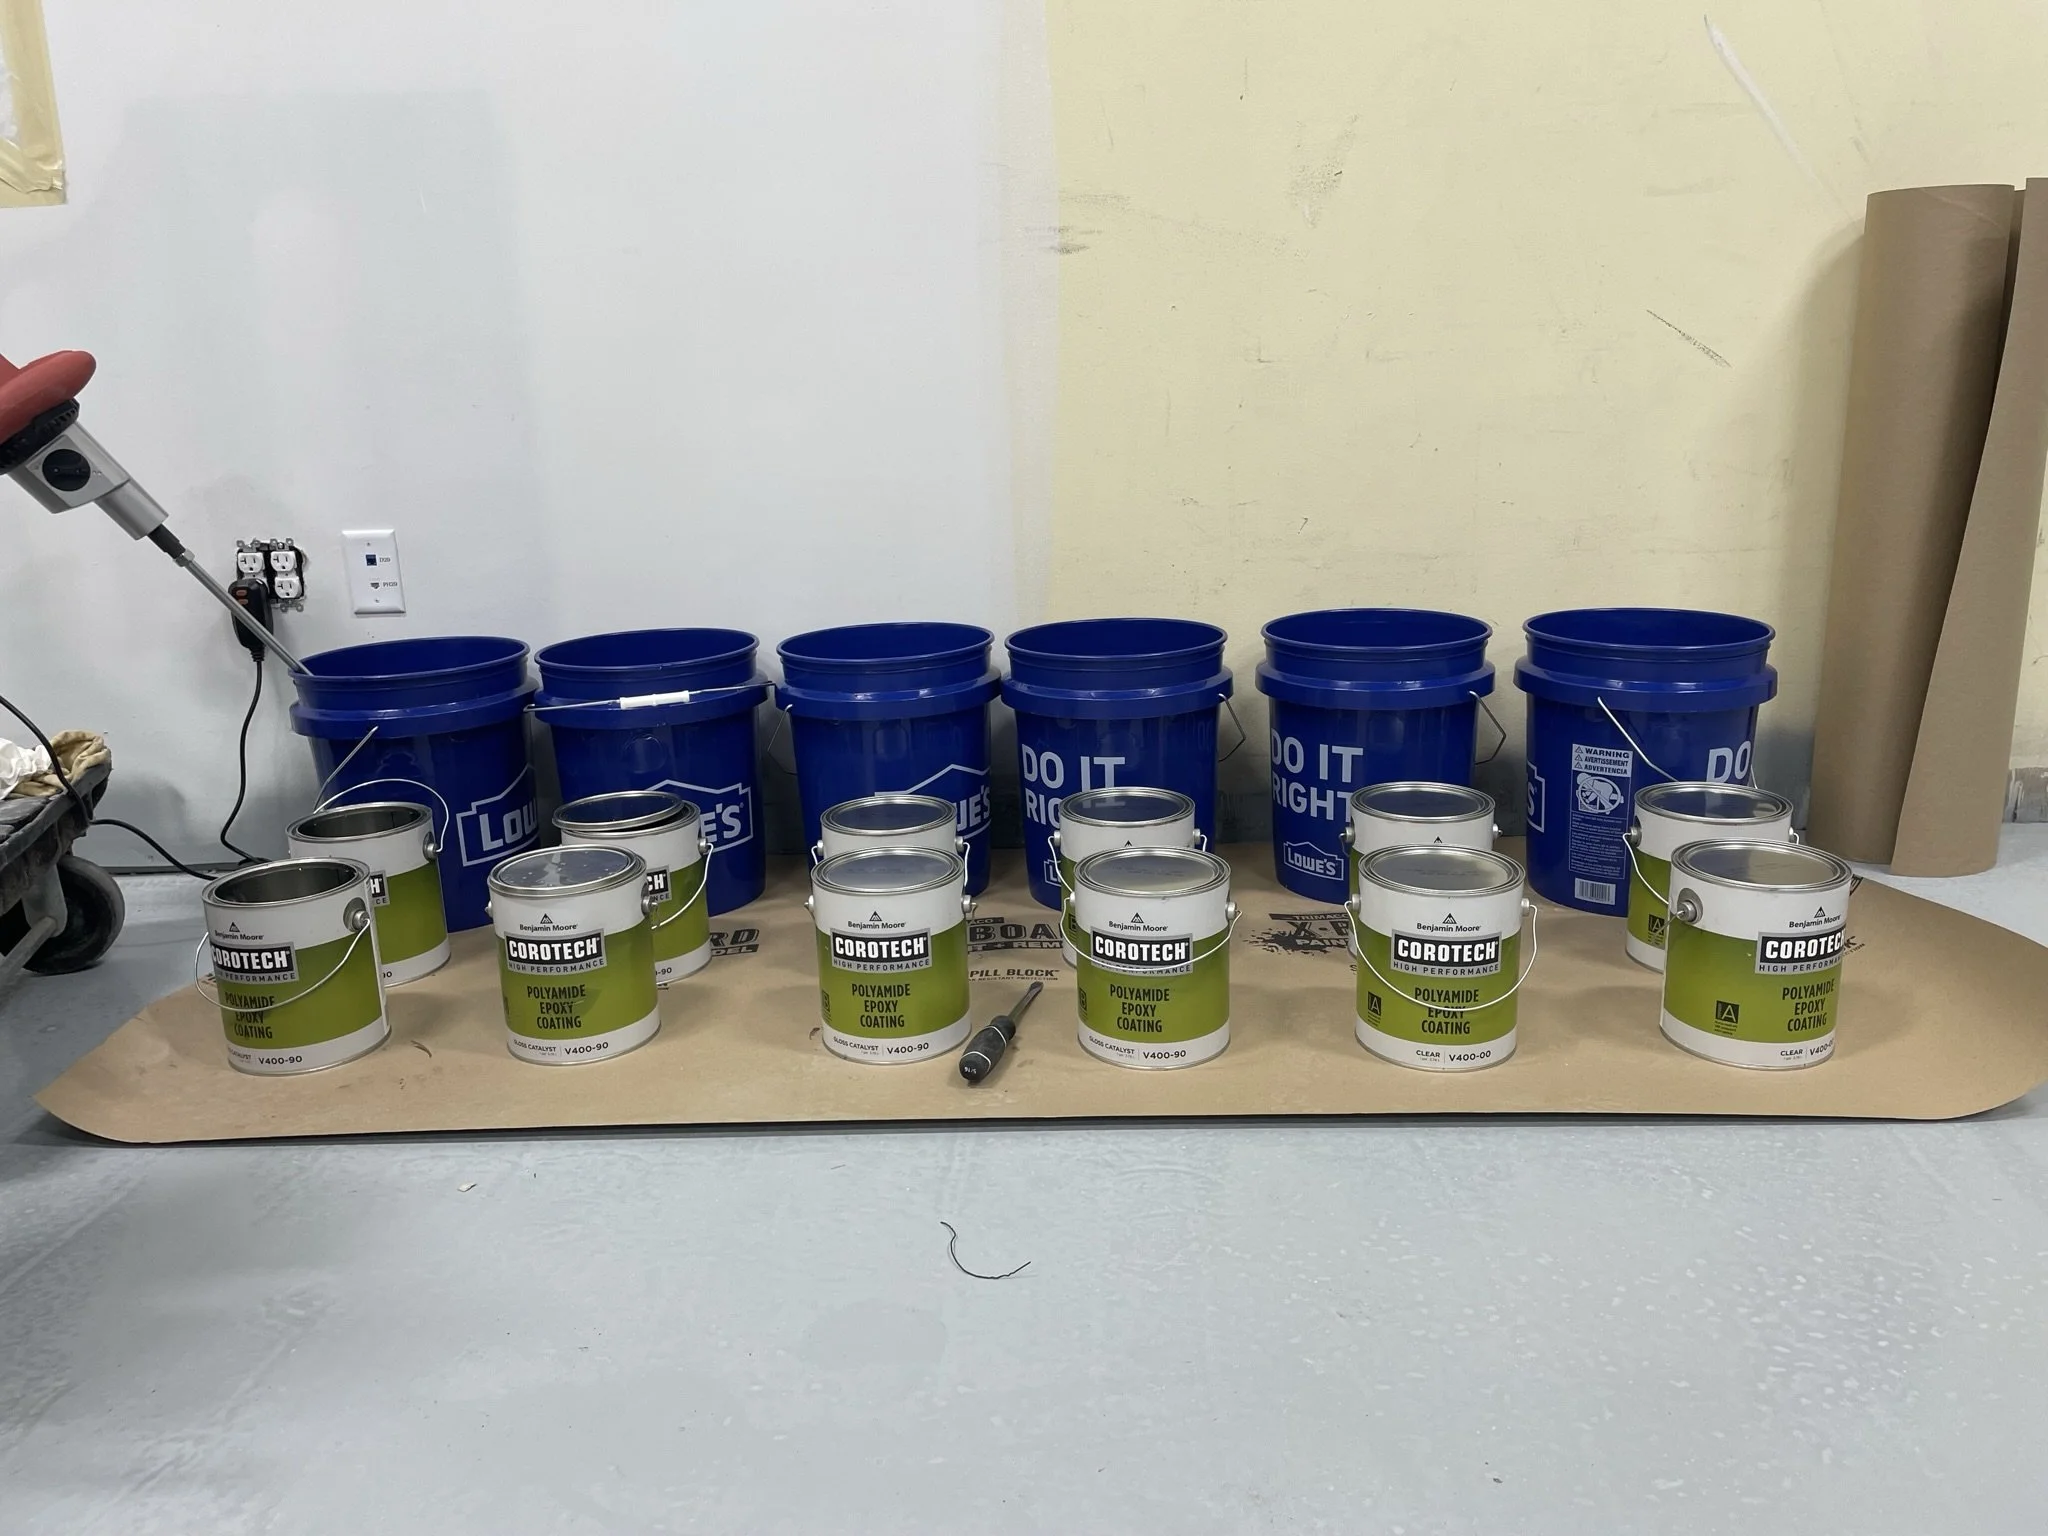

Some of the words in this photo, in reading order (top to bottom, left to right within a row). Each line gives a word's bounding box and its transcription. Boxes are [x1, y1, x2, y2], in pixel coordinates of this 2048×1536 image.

[1270, 728, 1304, 774] DO
[1319, 743, 1364, 784] IT
[1585, 747, 1630, 759] WARNING
[1022, 743, 1064, 789] DO
[1080, 756, 1126, 793] IT
[1584, 756, 1629, 767] AVERTISSEMENT
[1706, 740, 1751, 783] DO
[1583, 764, 1628, 775] ADVERTENCIA
[1272, 769, 1354, 823] RIGHT
[478, 797, 538, 852] LOW
[700, 803, 742, 843] E'S
[1287, 847, 1337, 876] LOWE'S
[519, 924, 551, 932] Benjamin
[848, 921, 880, 930] Benjamin
[1109, 920, 1141, 931] Benjamin
[1417, 923, 1454, 932] Benjamin
[1789, 920, 1823, 929] Benjamin
[508, 937, 598, 961] COROTECH
[835, 936, 925, 959] COROTECH
[1095, 935, 1186, 962] COROTECH
[1295, 938, 1349, 946] PAIN
[1398, 938, 1497, 963] COROTECH
[509, 961, 526, 971] HIGH
[530, 958, 604, 973] PERFORMANCE
[833, 959, 852, 968] HIGH
[857, 958, 930, 971] PERFORMANCE
[1393, 961, 1417, 972] HIGH
[1423, 963, 1499, 976] PERFORMANCE
[1759, 964, 1787, 972] HIGH
[969, 969, 1000, 977] PILL
[527, 984, 587, 999] POLYAMIDE
[851, 983, 911, 998] POLYAMIDE
[1110, 984, 1170, 1001] POLYAMIDE
[1414, 987, 1479, 1004] POLYAMIDE
[1782, 978, 1835, 1000] POLYAMIDE
[539, 1001, 573, 1015] EPOXY
[864, 1000, 899, 1013] EPOXY
[1122, 1002, 1157, 1017] EPOXY
[1428, 1005, 1466, 1019] EPOXY
[1794, 998, 1826, 1016] EPOXY
[536, 1015, 582, 1029] COATING
[860, 1015, 905, 1028] COATING
[1117, 1017, 1163, 1033] COATING
[1421, 1020, 1471, 1035] COATING
[1787, 1012, 1828, 1032] COATING
[234, 1023, 273, 1039] COATING
[528, 1044, 557, 1052] CATALYST
[564, 1041, 609, 1055] V400-90
[849, 1042, 879, 1051] CATALYST
[887, 1042, 930, 1054] V400-90
[1105, 1043, 1135, 1055] CATALYST
[1143, 1050, 1187, 1060] V400-90
[1415, 1049, 1441, 1058] CLEAR
[1449, 1050, 1492, 1062] V400-00
[1780, 1048, 1804, 1057] CLEAR
[258, 1055, 303, 1065] V400-90
